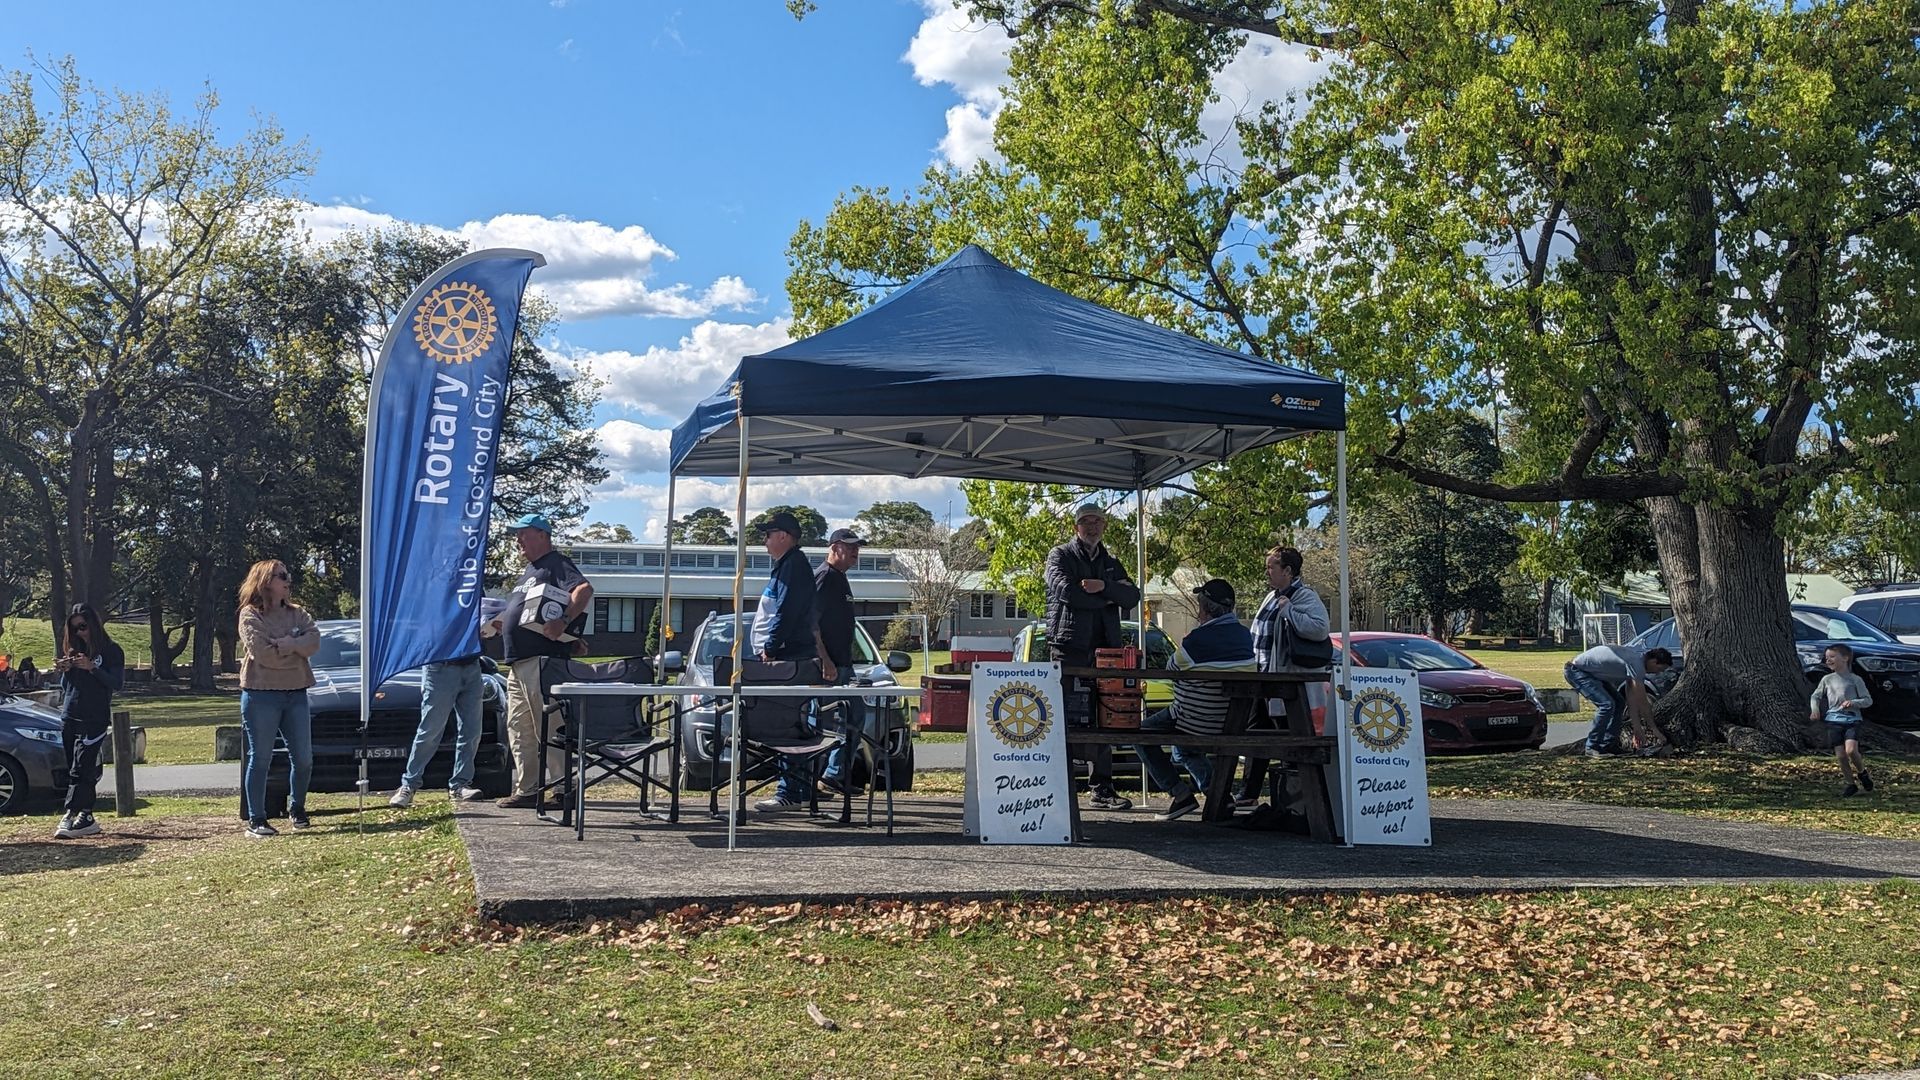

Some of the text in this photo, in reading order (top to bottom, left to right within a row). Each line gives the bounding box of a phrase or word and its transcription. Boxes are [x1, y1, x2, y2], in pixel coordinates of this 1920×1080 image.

[422, 301, 436, 337] ROTARY
[463, 296, 489, 353] INTERNATIONAL
[1285, 397, 1320, 406] OZtrail
[415, 373, 468, 504] Rotary
[457, 374, 501, 608] Club of Gosford City
[986, 668, 1048, 678] Supported by
[1350, 674, 1407, 686] upported by
[1004, 688, 1032, 697] ROTARY
[997, 722, 1044, 742] INTERNATIONAL
[993, 753, 1051, 763] Gosford City
[1355, 756, 1410, 768] Gosford City
[995, 775, 1046, 795] Please
[1357, 777, 1407, 797] Please
[997, 792, 1054, 817] support
[1360, 796, 1414, 818] support
[1020, 813, 1046, 833] us!
[1383, 815, 1406, 834] us!
